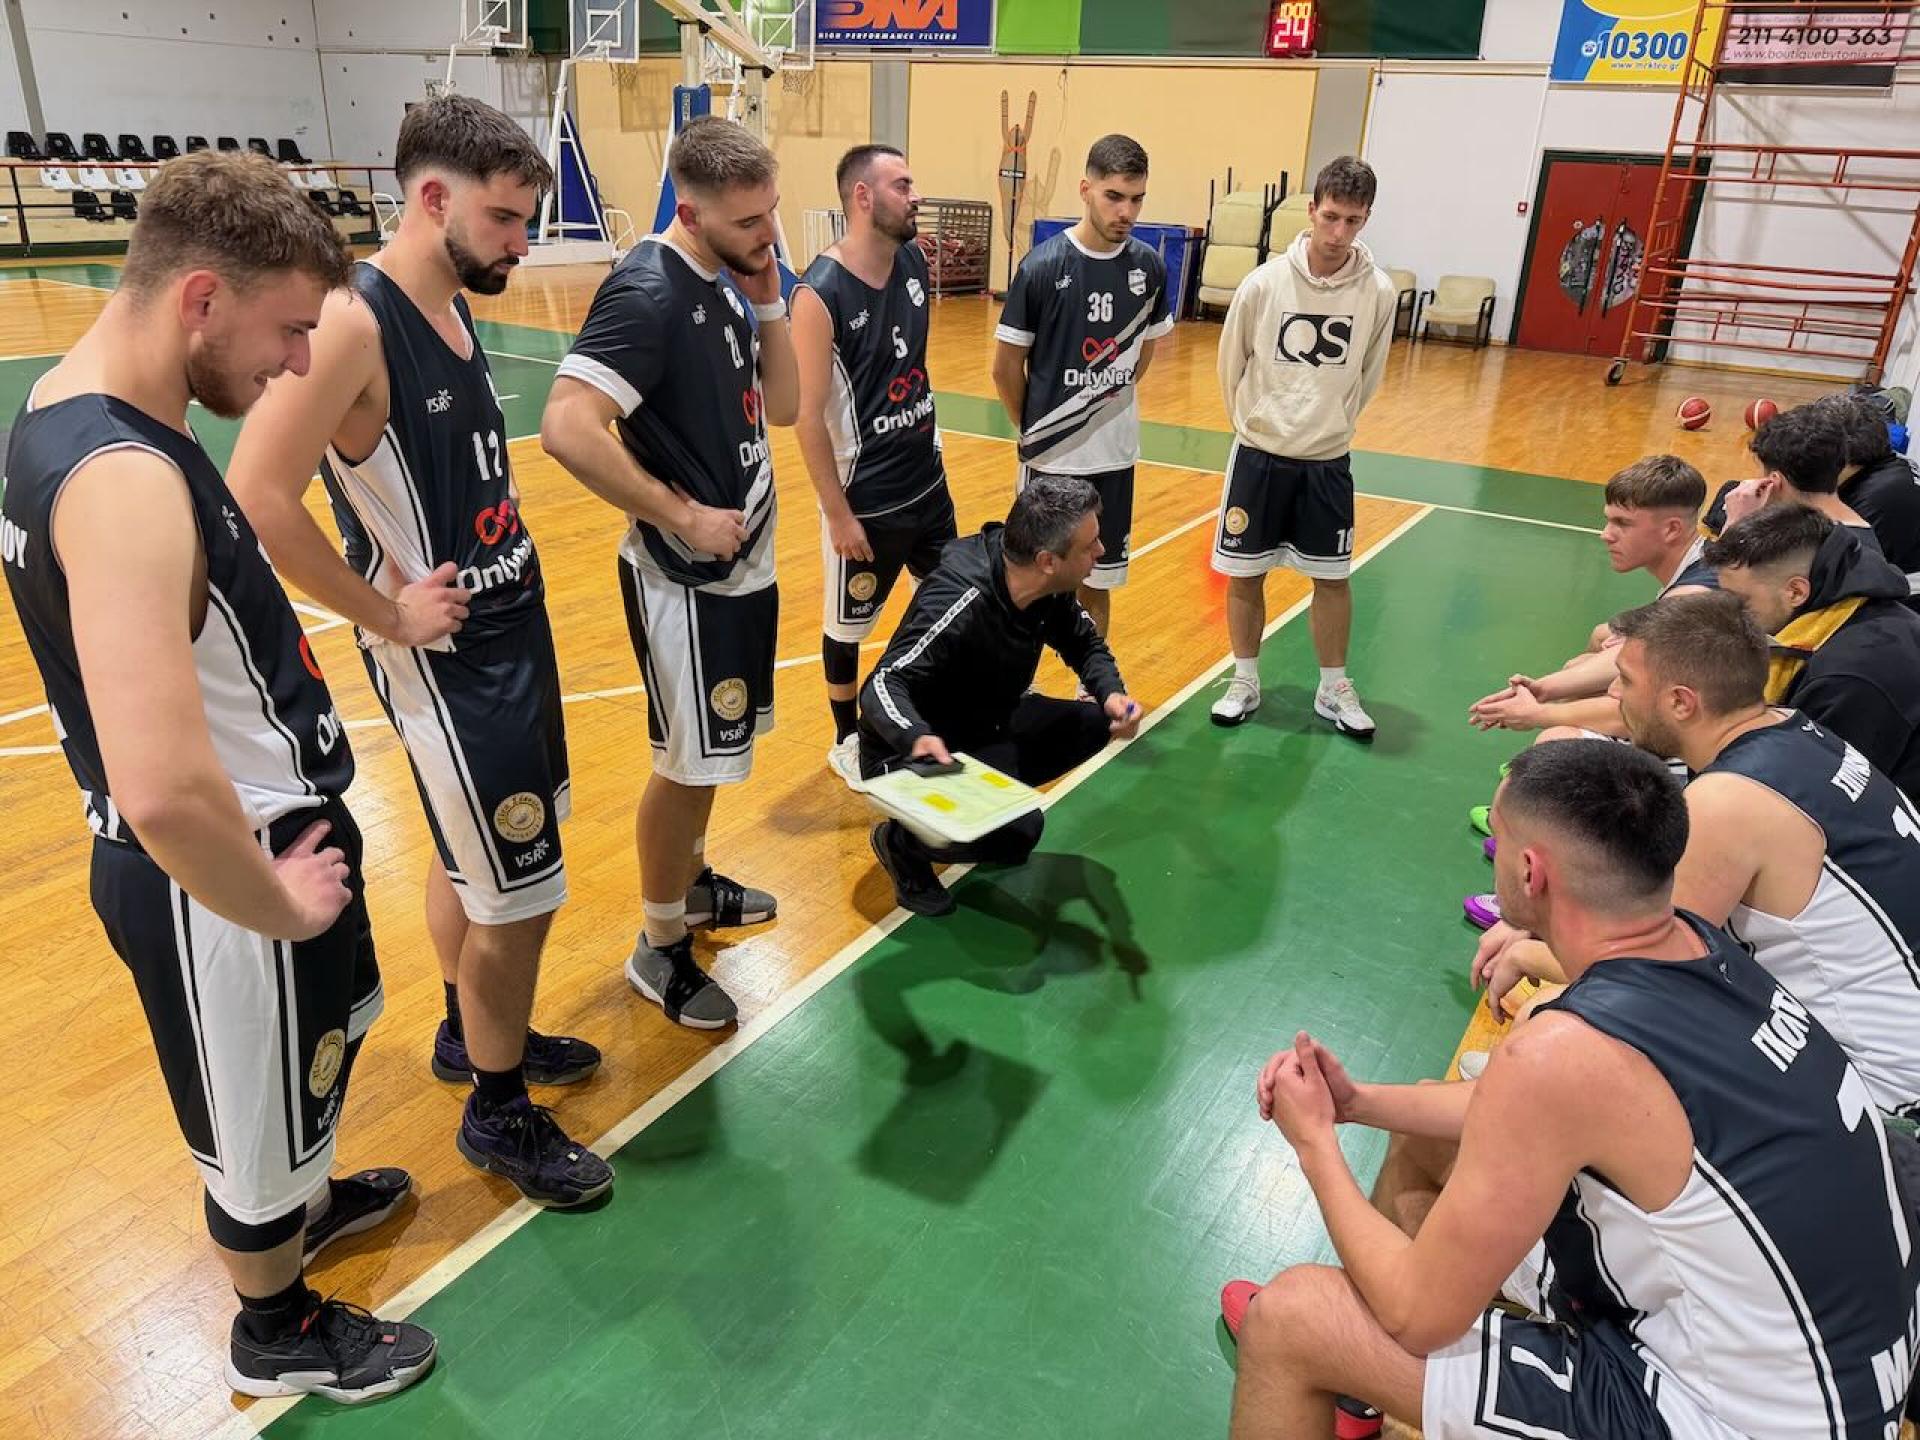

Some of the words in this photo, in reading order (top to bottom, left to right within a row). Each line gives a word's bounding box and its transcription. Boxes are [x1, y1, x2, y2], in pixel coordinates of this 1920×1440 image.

[818, 32, 842, 40] HIGH
[845, 32, 914, 40] PERFORMANCE
[918, 32, 958, 40] FILTERS
[1273, 18, 1311, 49] 24
[1597, 30, 1690, 60] 10300
[1737, 27, 1772, 45] 211
[1779, 26, 1839, 46] 4100
[1847, 26, 1892, 46] 363
[1087, 292, 1114, 323] 36
[892, 325, 908, 360] 5
[1276, 313, 1353, 368] QS
[1063, 367, 1133, 391] OnlyNet
